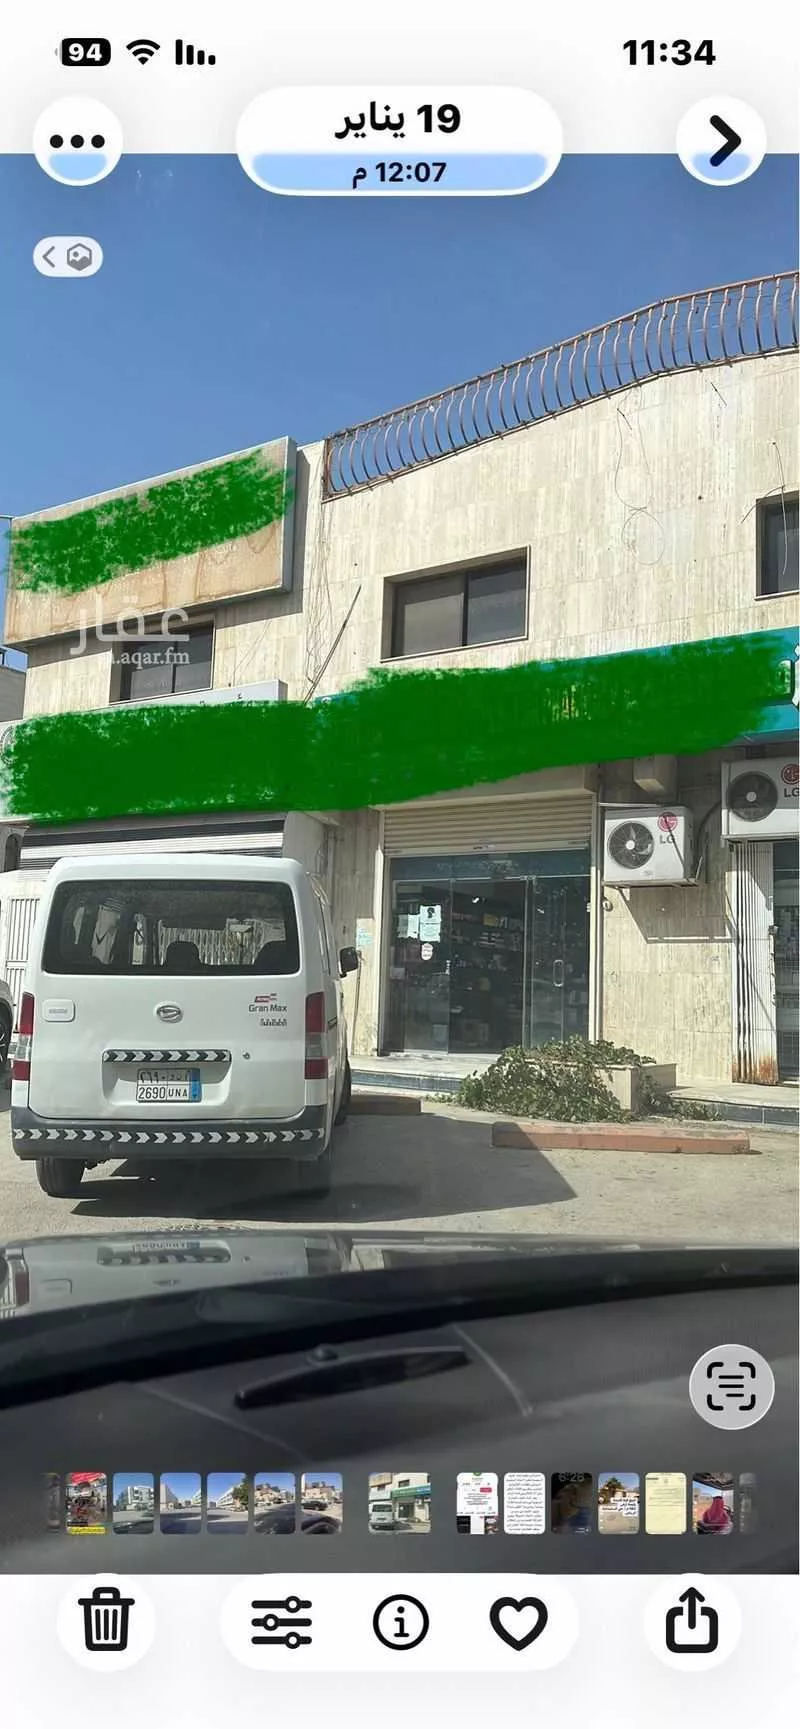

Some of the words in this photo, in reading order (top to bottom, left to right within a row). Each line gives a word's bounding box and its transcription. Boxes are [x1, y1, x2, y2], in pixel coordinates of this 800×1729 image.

[783, 788, 799, 798] LG
[248, 1004, 269, 1013] Gran
[270, 1004, 288, 1013] Max
[138, 1086, 166, 1099] 2690
[168, 1088, 188, 1097] UNA
